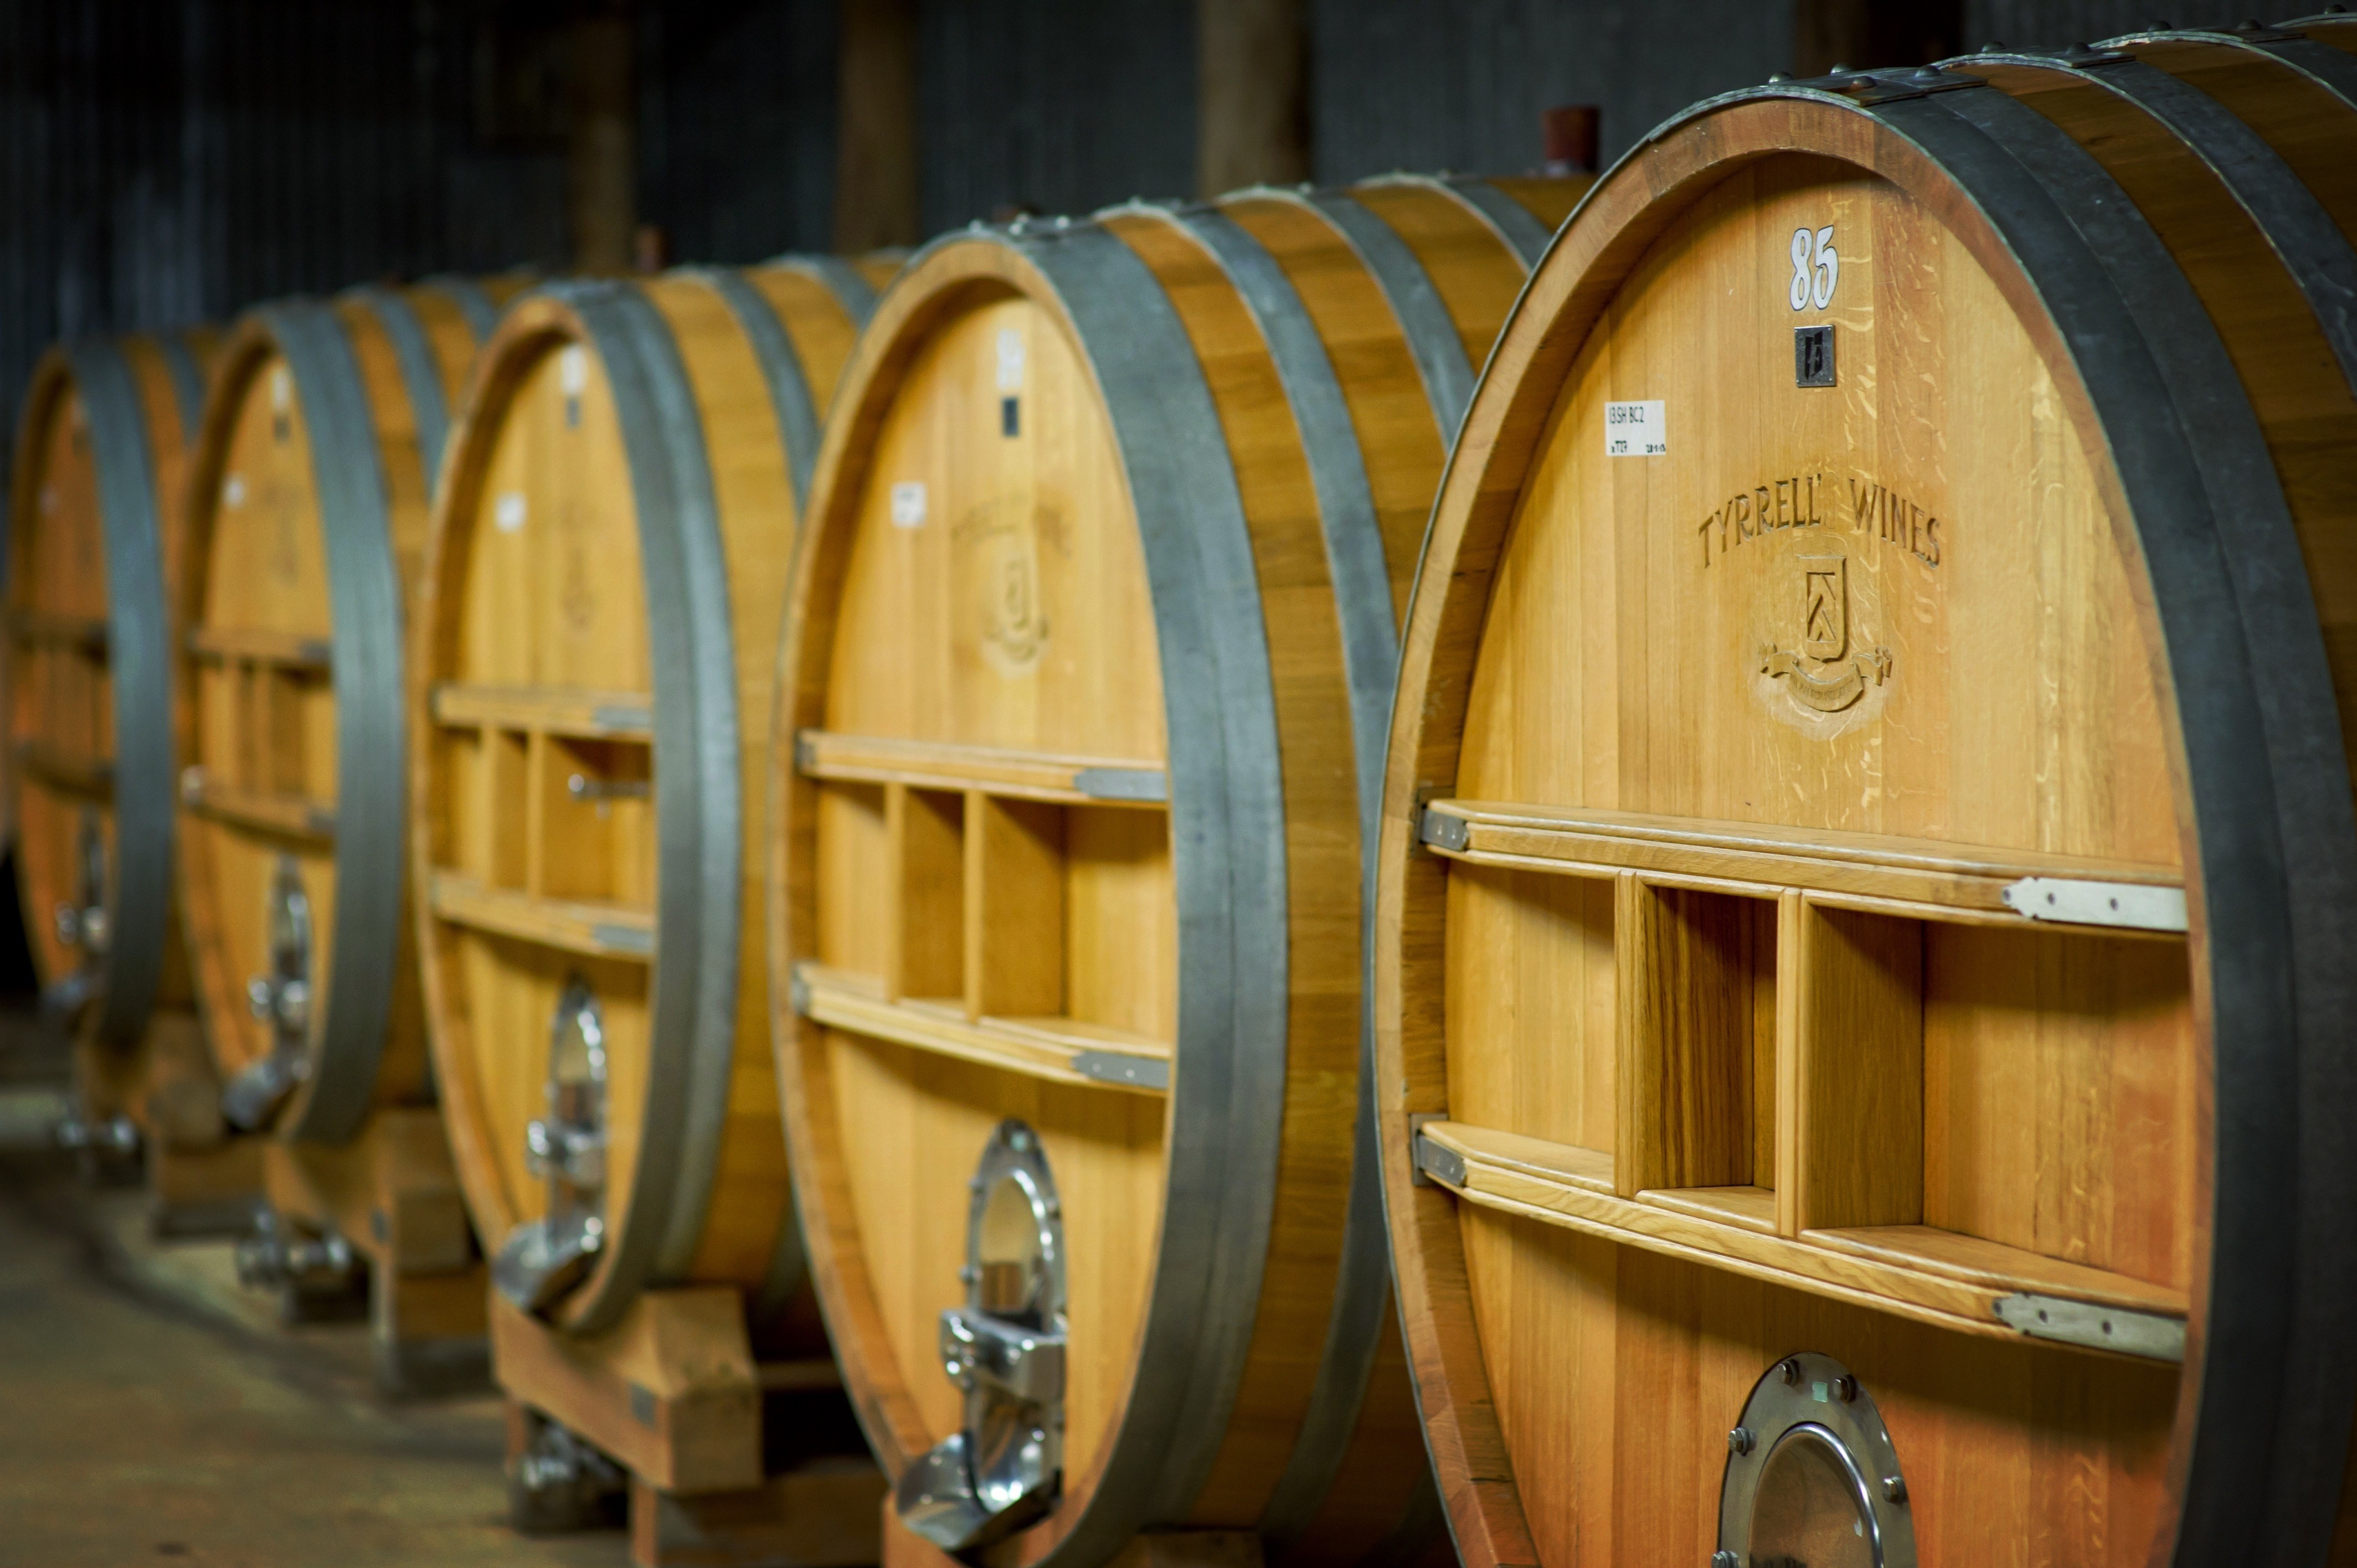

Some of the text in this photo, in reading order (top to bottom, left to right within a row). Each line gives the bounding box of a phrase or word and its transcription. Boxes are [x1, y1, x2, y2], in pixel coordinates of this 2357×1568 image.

[1789, 224, 1839, 311] 85
[1699, 472, 1941, 569] TYRRELL' WINES
